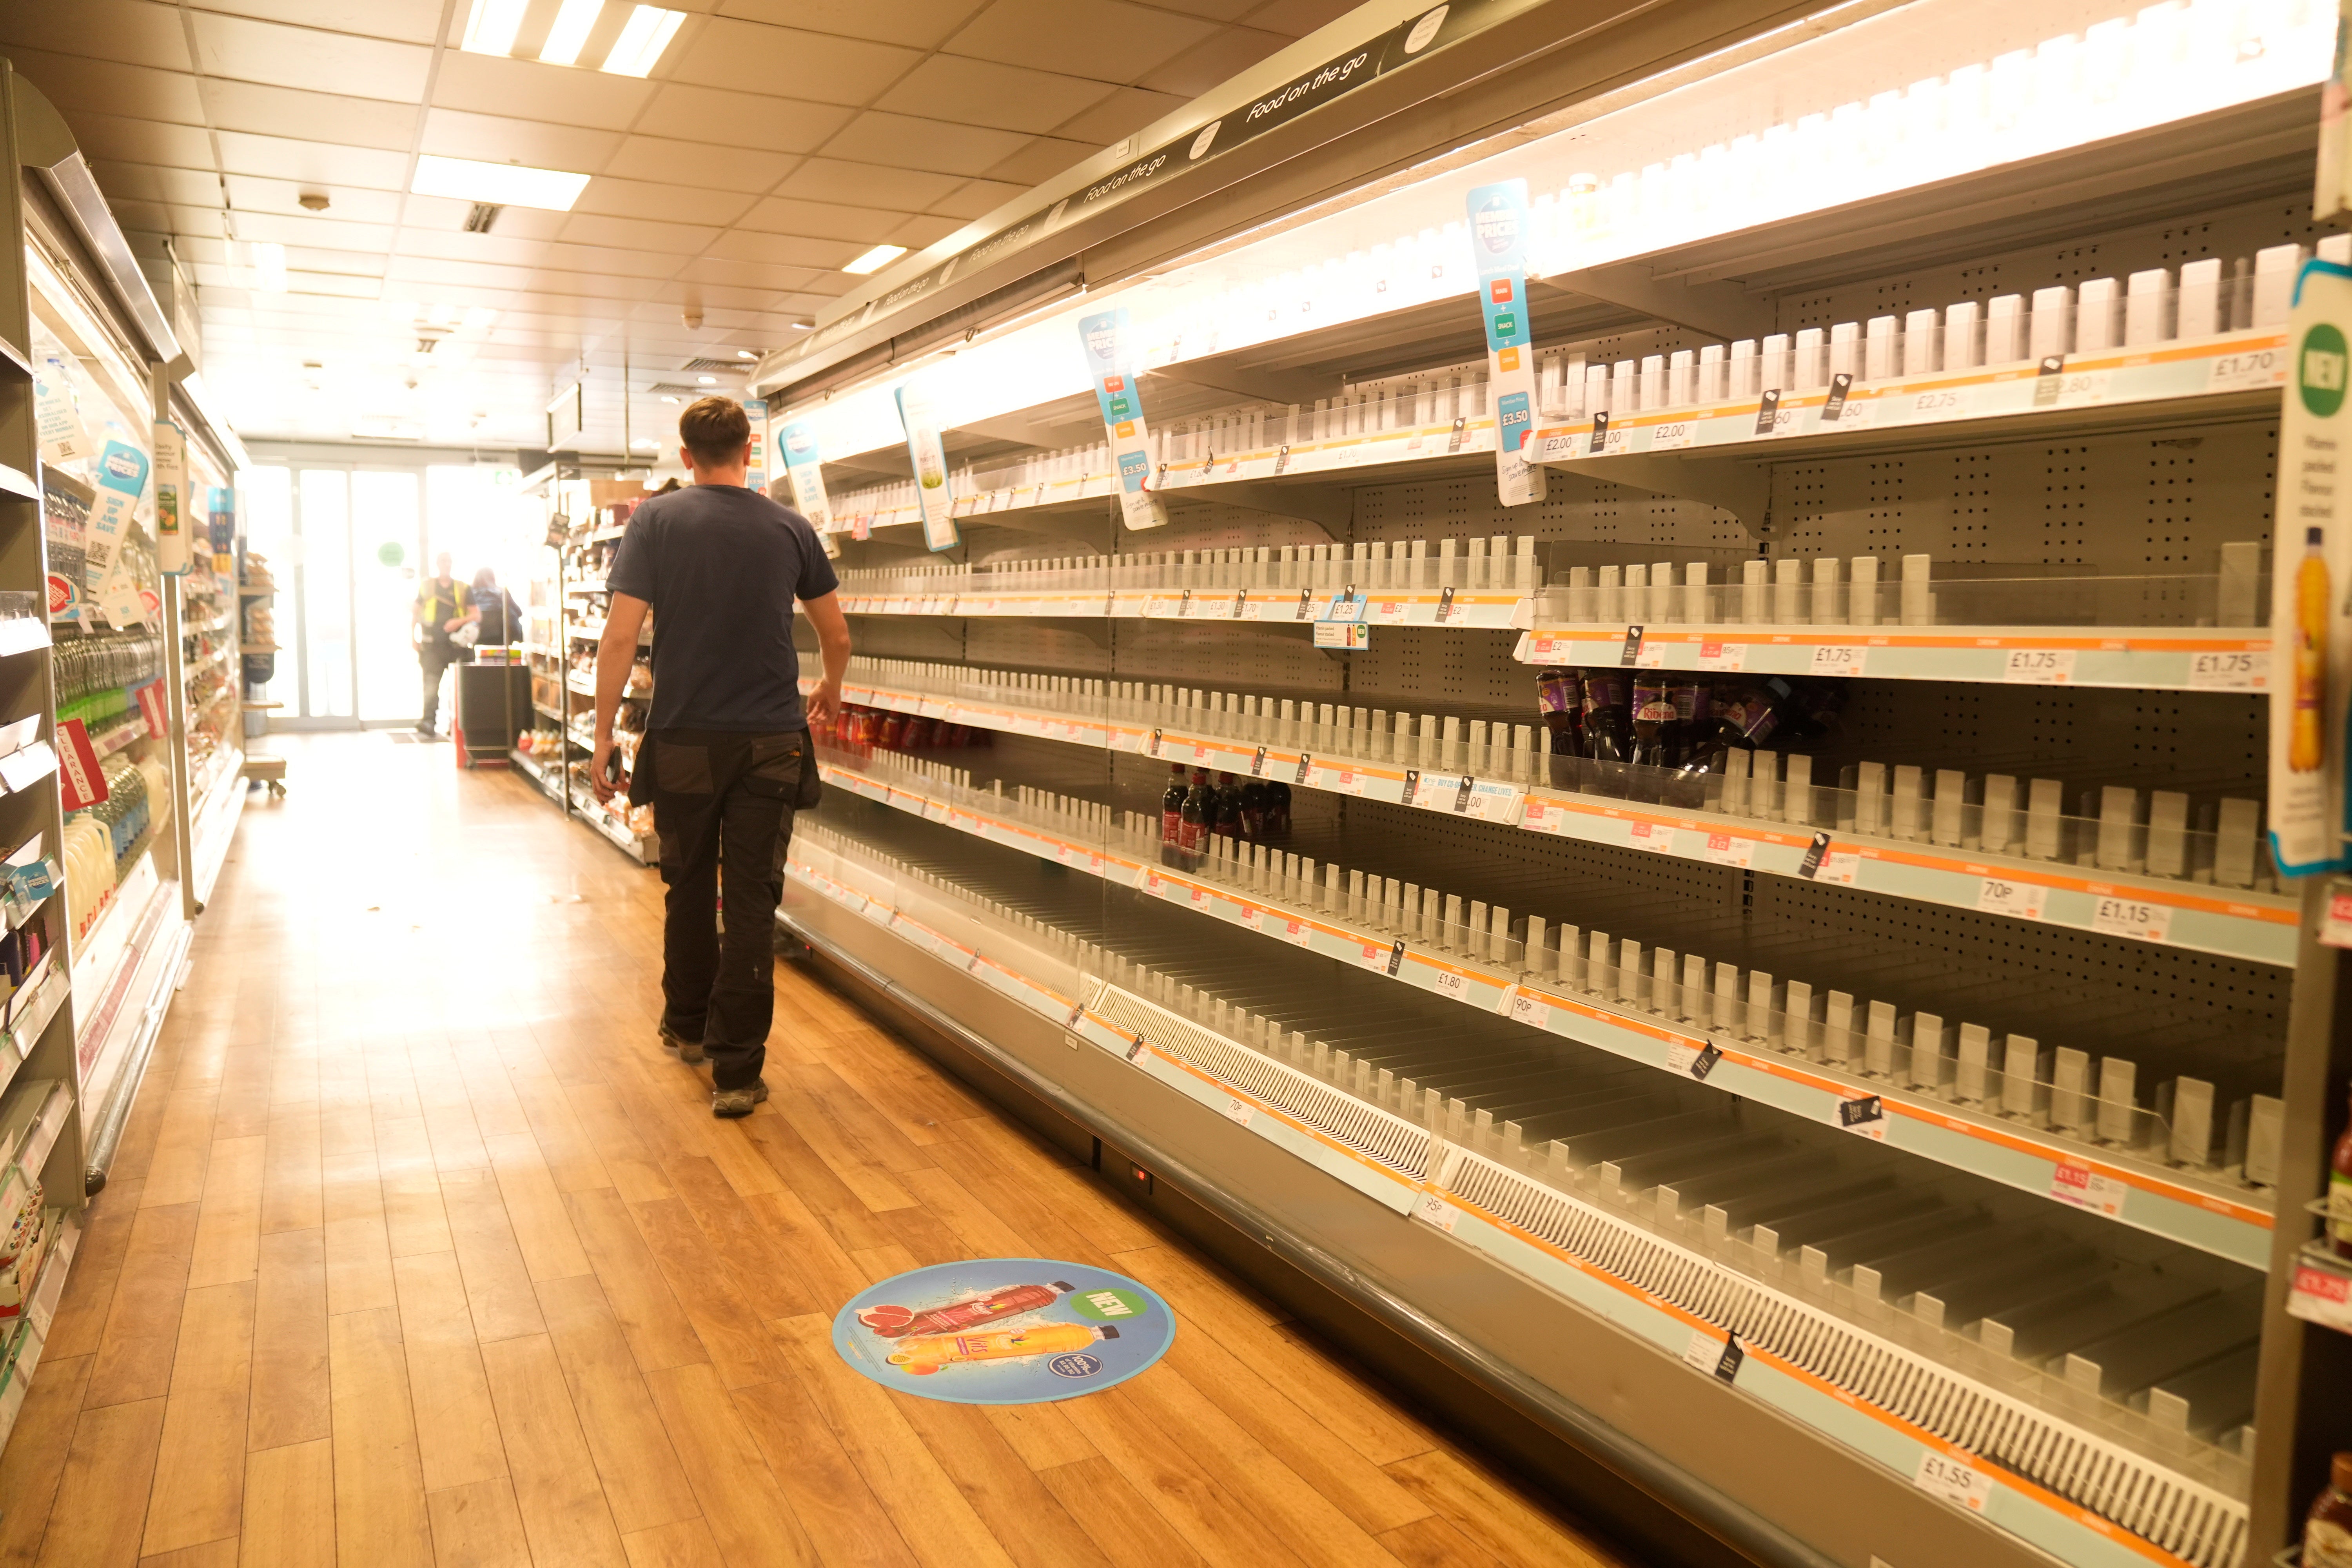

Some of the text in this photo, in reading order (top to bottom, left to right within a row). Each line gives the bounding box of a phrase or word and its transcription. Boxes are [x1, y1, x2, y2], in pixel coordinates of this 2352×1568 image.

[1246, 53, 1367, 123] Food on the go
[1083, 155, 1166, 203] Food on the go
[1476, 220, 1519, 239] PRICES
[969, 225, 1029, 263] Food on the go
[1497, 321, 1512, 330] SNACK
[2215, 352, 2273, 376] £1.70
[1916, 393, 1956, 410] £2.75
[1503, 410, 1528, 426] £3.50
[1655, 425, 1684, 439] £2.00
[1546, 437, 1572, 451] £2.00
[1339, 448, 1357, 459] £1.70
[105, 461, 139, 478] PRICES
[1123, 463, 1147, 475] £3.50
[1190, 470, 1204, 478] £1.60
[1502, 465, 1511, 475] Sign
[1512, 463, 1519, 472] up
[1508, 463, 1537, 481] save more
[106, 496, 125, 508] SIGN
[107, 506, 118, 515] UP
[102, 514, 118, 525] AND
[1210, 602, 1225, 610] £1.30
[1335, 605, 1353, 614] £1.25
[1553, 642, 1562, 651] £2
[1815, 648, 1851, 662] £1.75
[2011, 653, 2056, 668] £1.75
[2196, 655, 2252, 672] £1.75
[1644, 708, 1674, 719] Ribena
[56, 728, 91, 801] CLEARANCE
[1498, 788, 1512, 796] LIVES.
[1680, 821, 1696, 829] DRINK
[28, 878, 49, 887] PRICES
[2100, 900, 2149, 923] £1.15
[1438, 973, 1460, 988] £1.80
[1595, 1012, 1610, 1021] DRINK
[970, 1302, 993, 1315] Rubicon
[1086, 1292, 1133, 1316] NEW
[966, 1336, 989, 1352] Vits
[1072, 1354, 1091, 1371] 100%
[1925, 1456, 1972, 1488] £1.55
